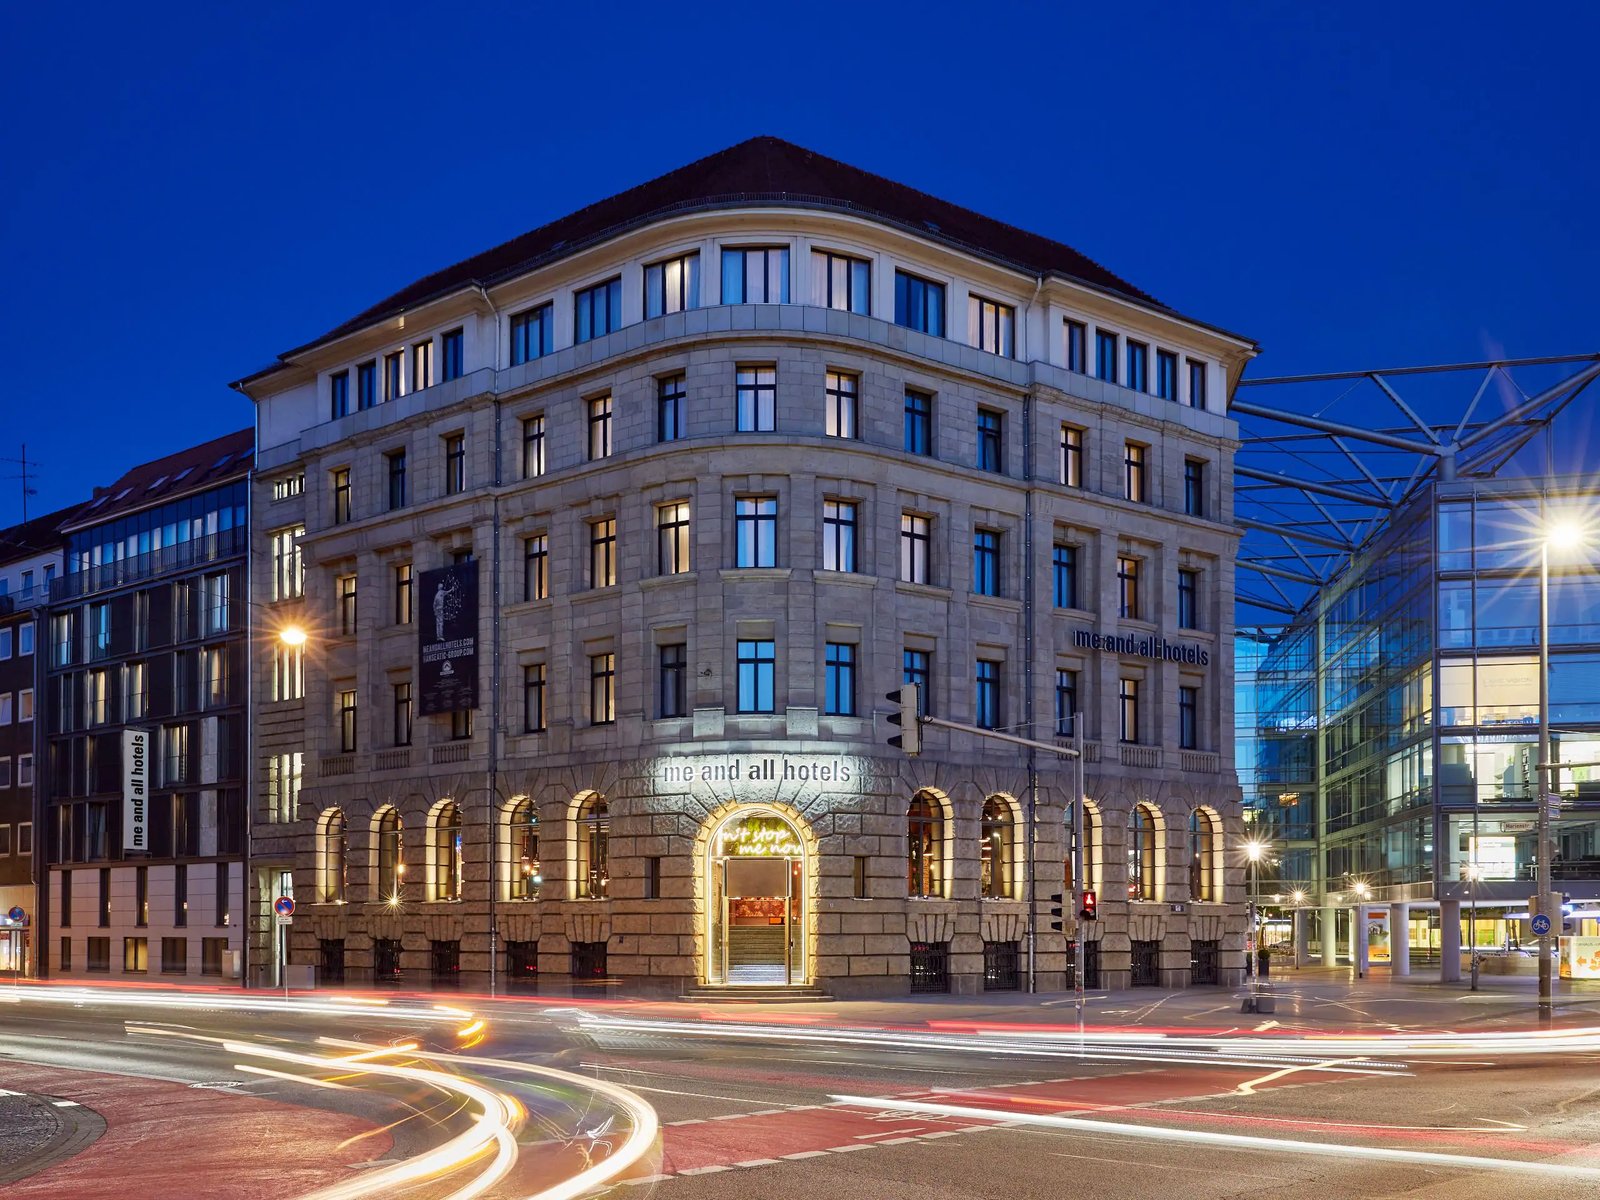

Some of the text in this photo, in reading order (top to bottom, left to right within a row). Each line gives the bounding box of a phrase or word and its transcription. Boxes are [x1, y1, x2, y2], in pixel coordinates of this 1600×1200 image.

[1074, 630, 1209, 666] me and all hotels
[664, 759, 851, 782] me and all hotels
[131, 735, 144, 846] me and all hotels
